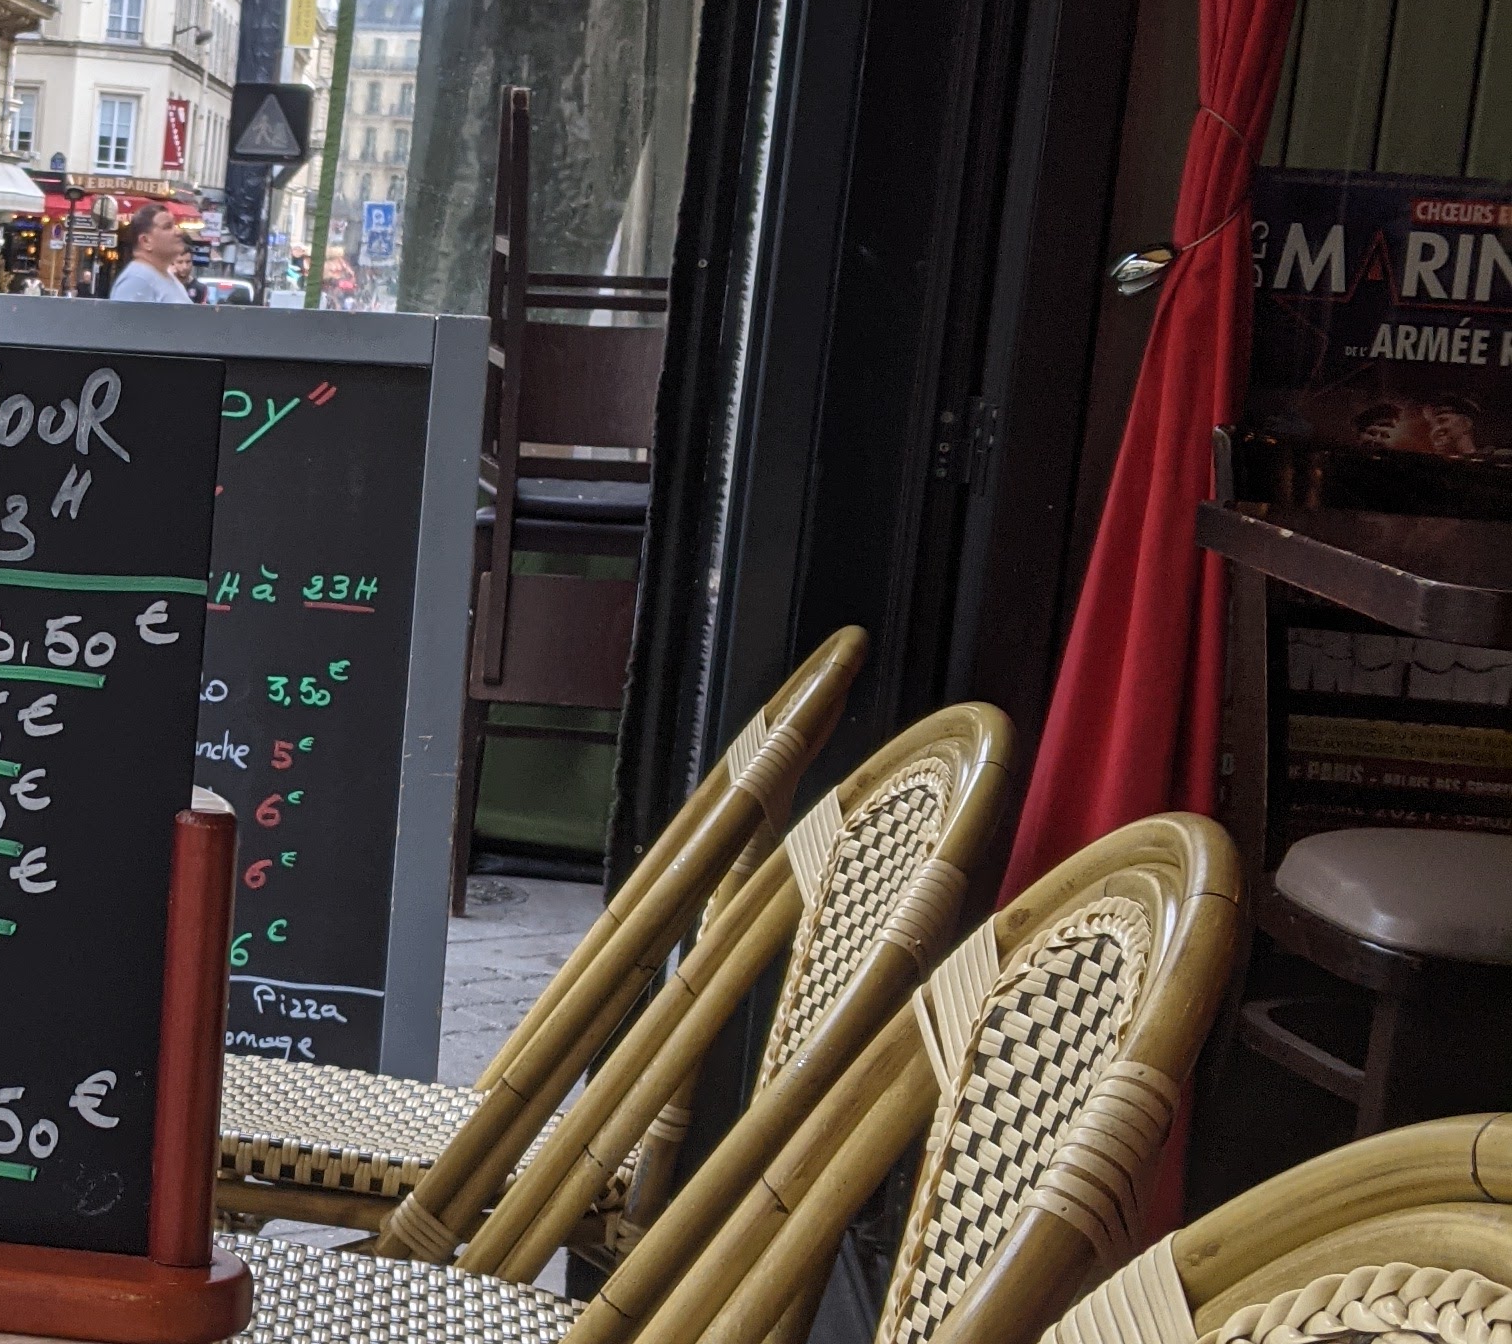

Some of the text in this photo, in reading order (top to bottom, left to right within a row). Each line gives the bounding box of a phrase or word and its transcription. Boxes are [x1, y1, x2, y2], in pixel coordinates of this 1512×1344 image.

[252, 564, 279, 602] à
[303, 575, 378, 600] 23H
[253, 985, 348, 1023] Pizza
